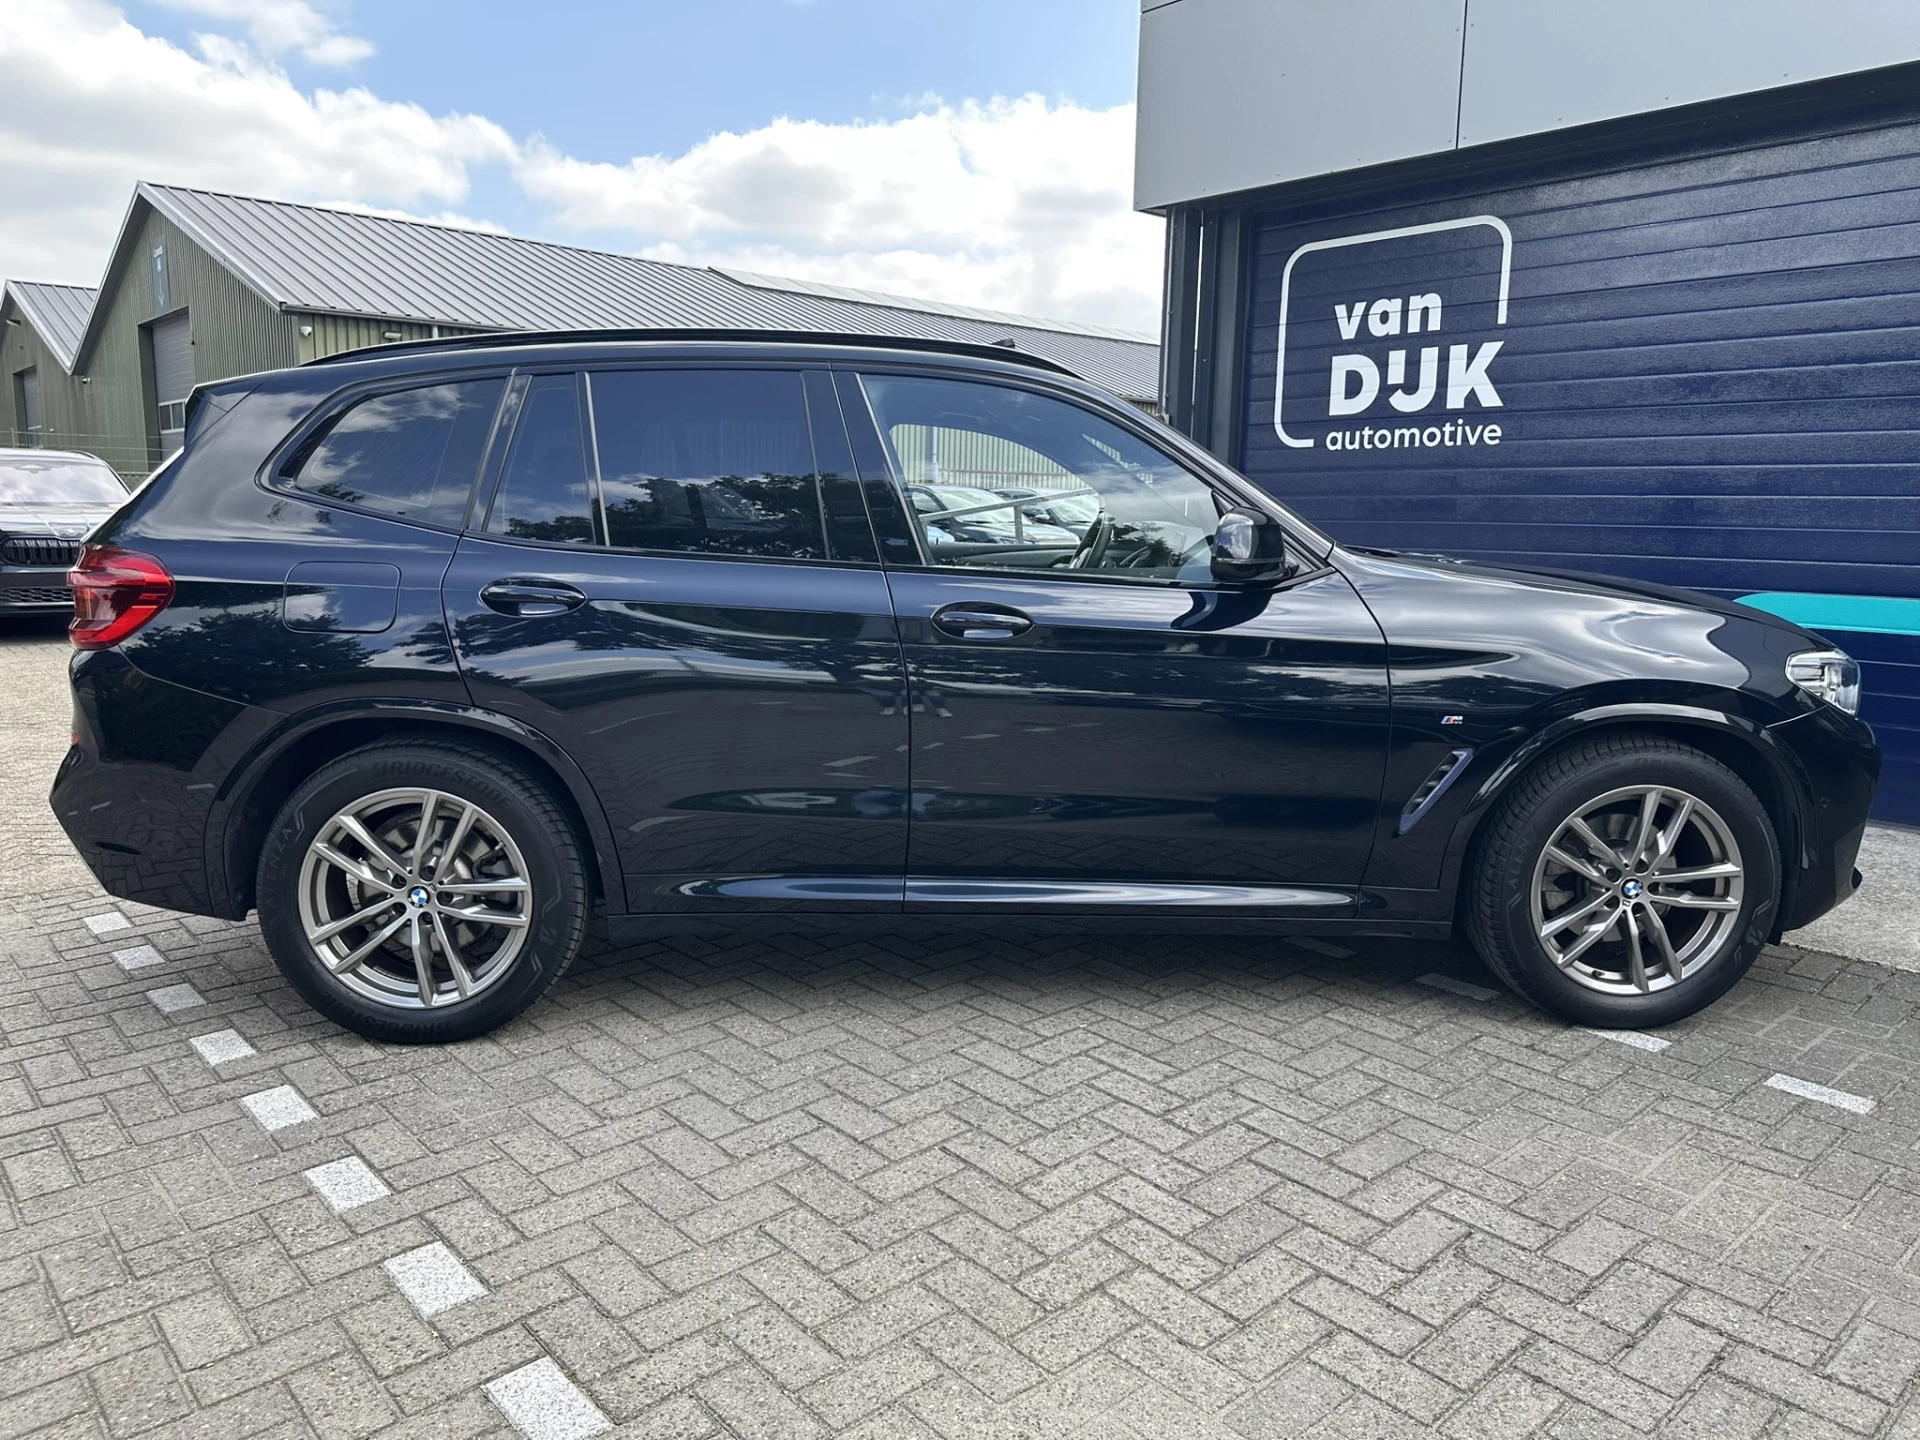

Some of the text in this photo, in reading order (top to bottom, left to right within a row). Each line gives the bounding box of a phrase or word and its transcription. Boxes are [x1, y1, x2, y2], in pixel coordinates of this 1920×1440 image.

[1334, 293, 1442, 340] van
[1329, 341, 1505, 416] DIJK
[1325, 418, 1502, 450] automotive
[371, 760, 513, 807] BRIDGESTONE
